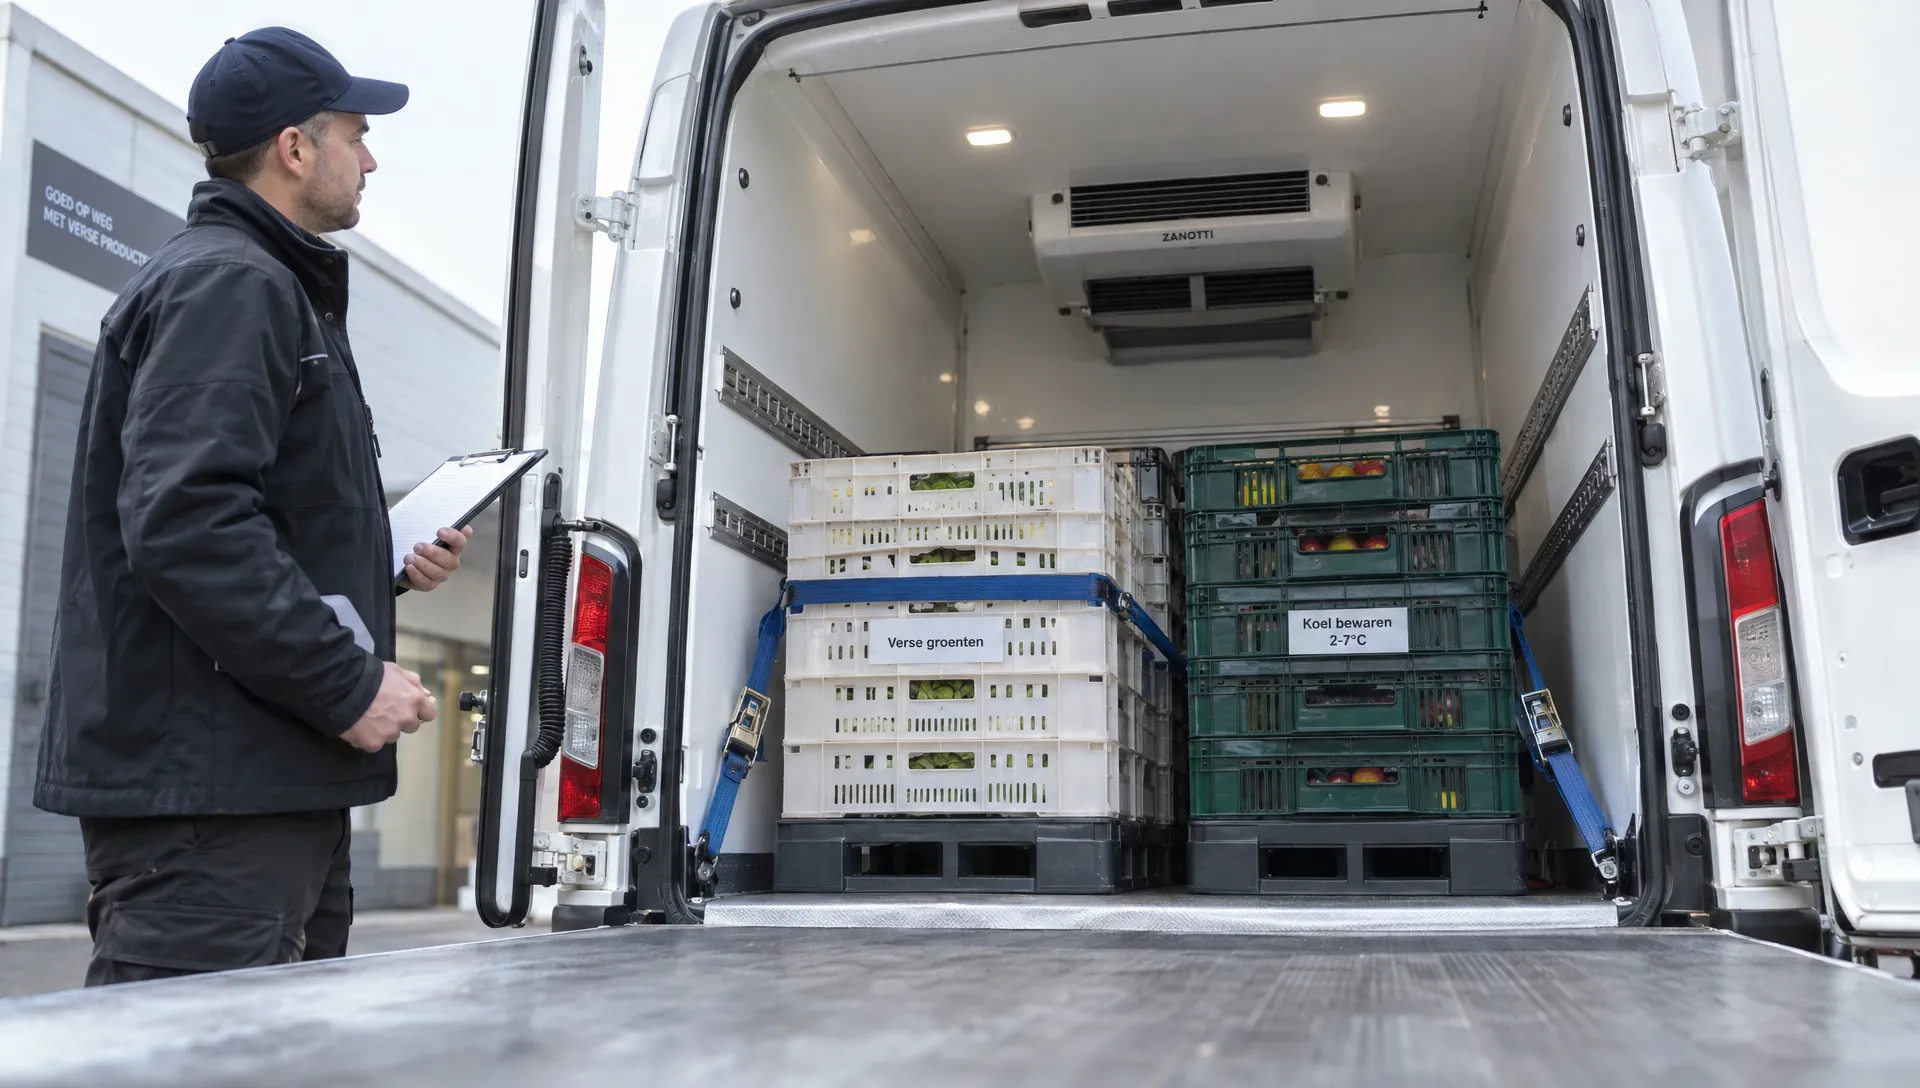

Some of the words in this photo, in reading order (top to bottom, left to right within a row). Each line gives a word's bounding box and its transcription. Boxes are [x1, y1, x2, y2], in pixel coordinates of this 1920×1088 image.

[45, 185, 74, 212] GOED
[75, 201, 91, 218] OP
[91, 207, 113, 231] WEG
[43, 206, 66, 229] MET
[68, 218, 99, 246] VERSE
[1162, 230, 1214, 242] ZANOTTI
[1303, 618, 1332, 629] Koel
[1336, 617, 1392, 629] bewaren
[888, 637, 923, 648] Verse
[927, 636, 984, 650] groenten
[1329, 634, 1367, 646] 2-7°C
